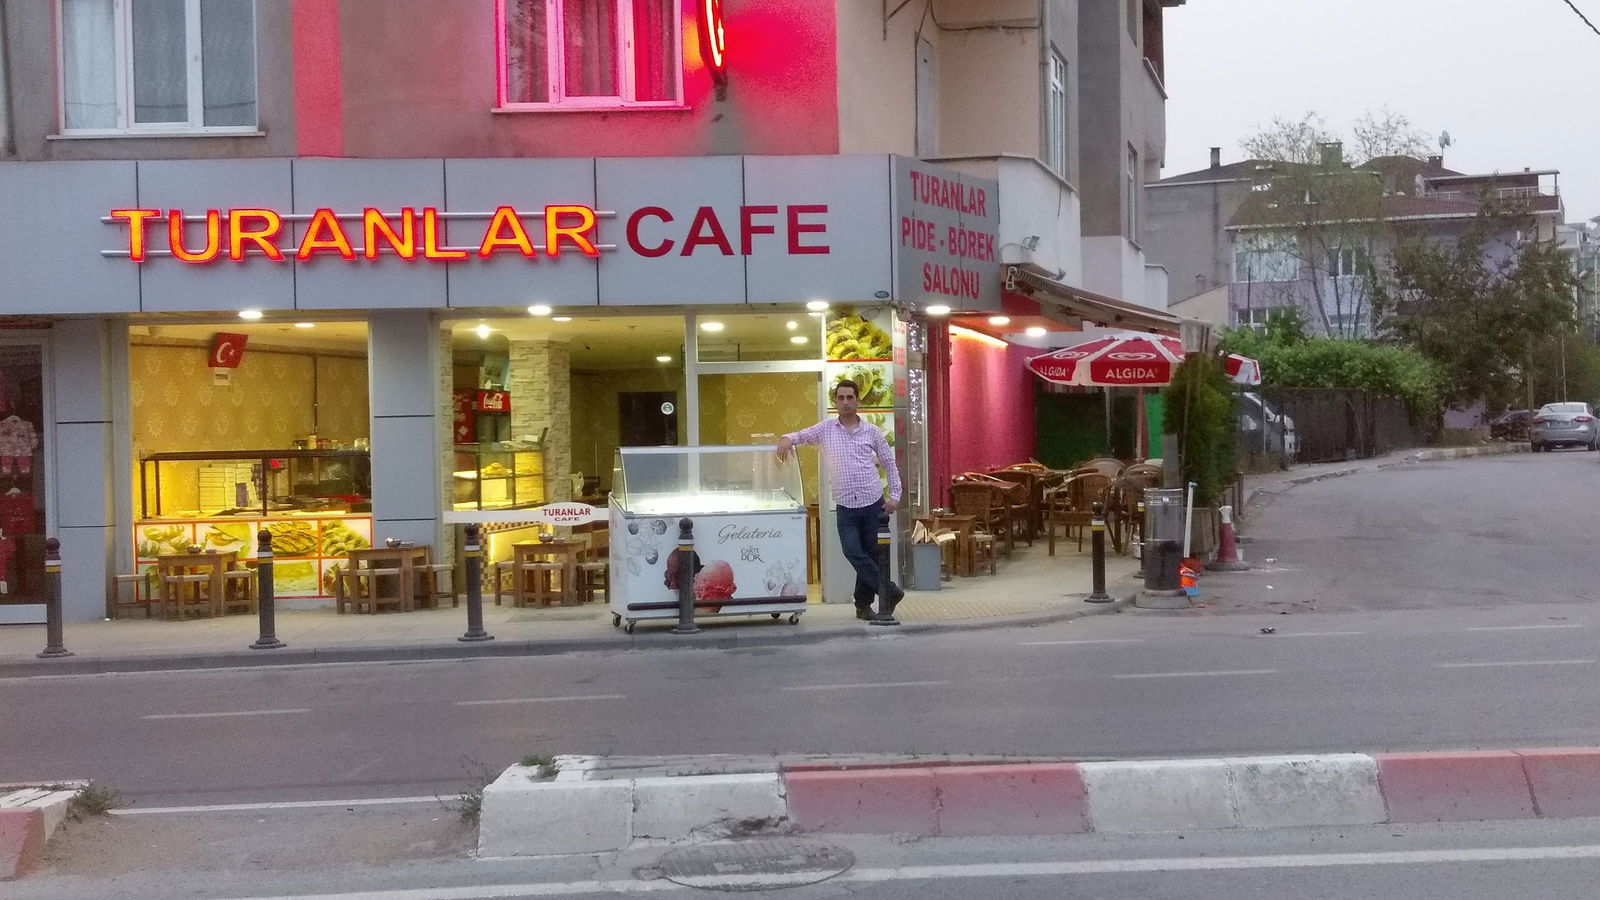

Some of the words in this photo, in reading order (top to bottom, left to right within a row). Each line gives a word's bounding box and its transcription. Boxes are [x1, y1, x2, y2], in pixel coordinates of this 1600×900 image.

[910, 170, 986, 217] TURANLAR
[110, 204, 599, 263] TURANLAR
[626, 204, 831, 258] CAFE
[901, 211, 936, 252] PİDE
[948, 222, 995, 262] BÖREK
[923, 262, 979, 300] SALONU
[542, 508, 592, 516] TURANLAR
[717, 523, 784, 545] Gelateria
